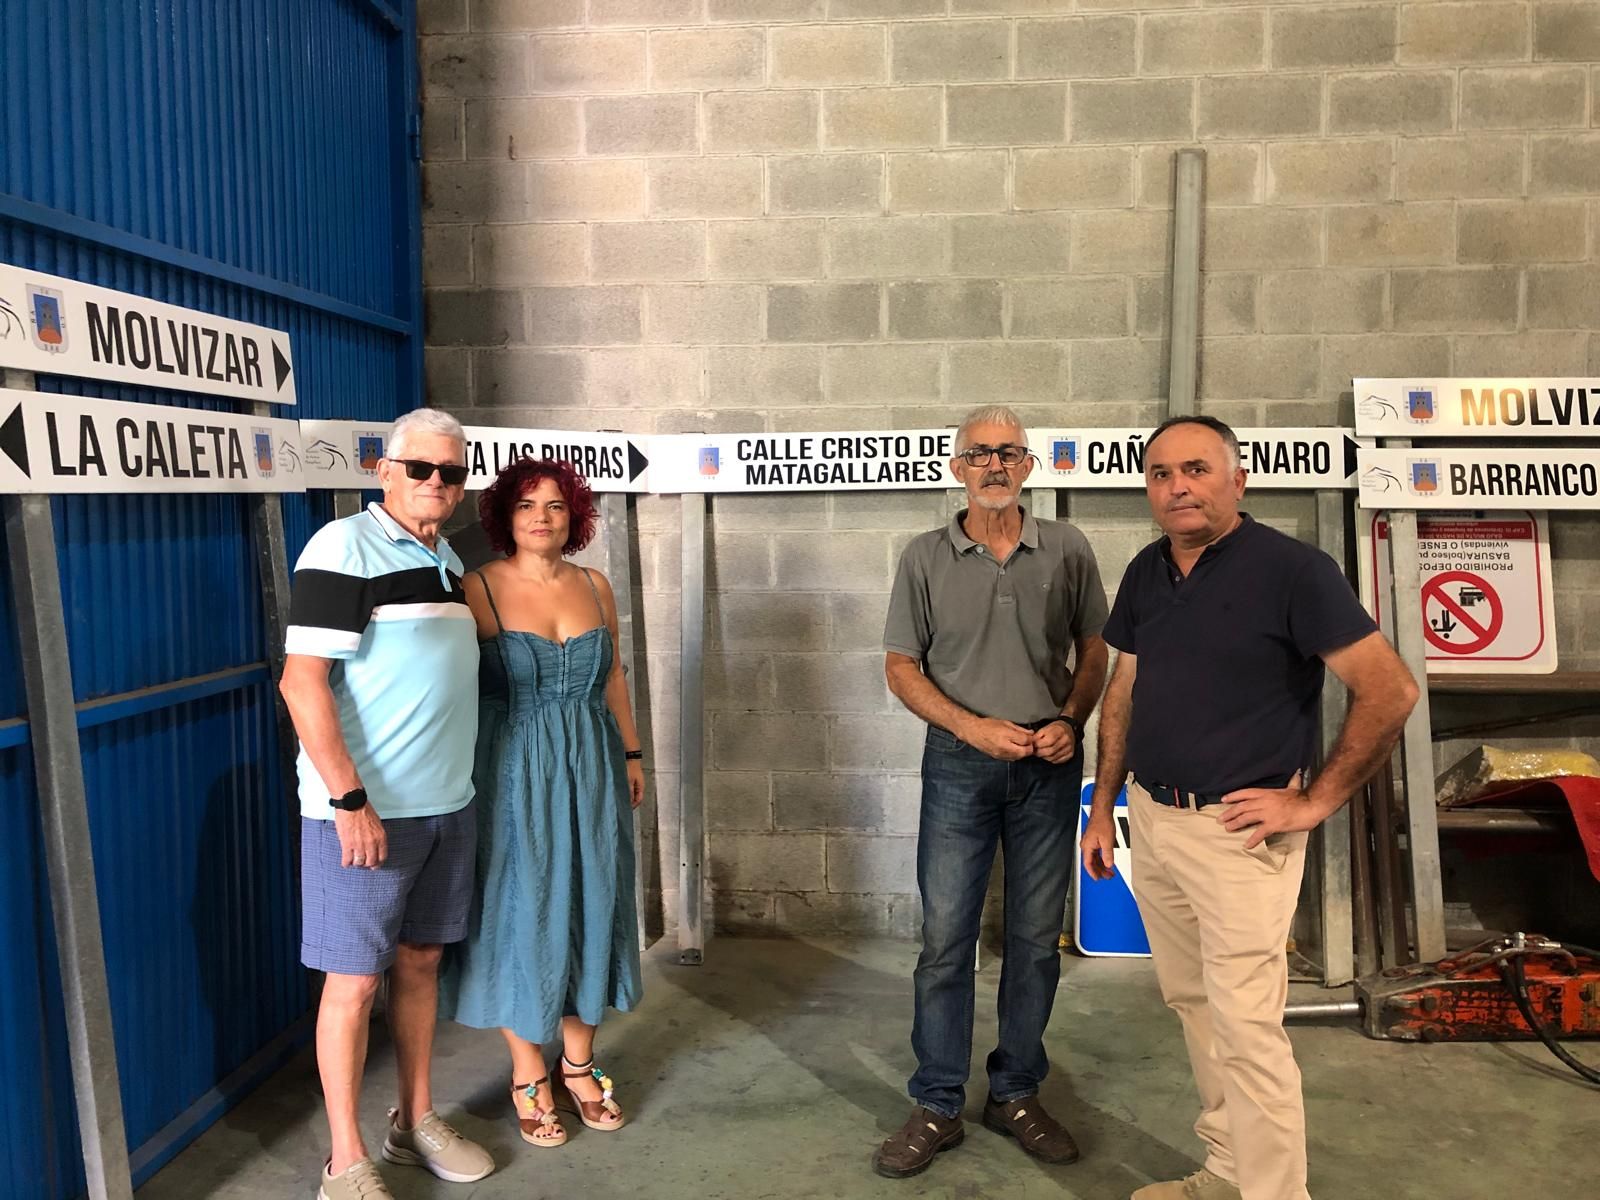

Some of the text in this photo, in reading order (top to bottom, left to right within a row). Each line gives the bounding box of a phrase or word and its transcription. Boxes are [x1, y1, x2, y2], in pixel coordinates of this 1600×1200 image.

[86, 301, 264, 387] MOLVIZAR
[46, 412, 248, 479] LA CALETA
[737, 435, 951, 461] CALLE CRISTO DE
[1088, 435, 1331, 474] CAÑ ENARO
[746, 461, 942, 485] MATAGALLARES
[1450, 463, 1597, 496] BARRANCO
[1418, 541, 1448, 549] ENSE
[1460, 541, 1509, 549] viviendas)
[1419, 562, 1513, 571] PROHIBIDO DEPOS
